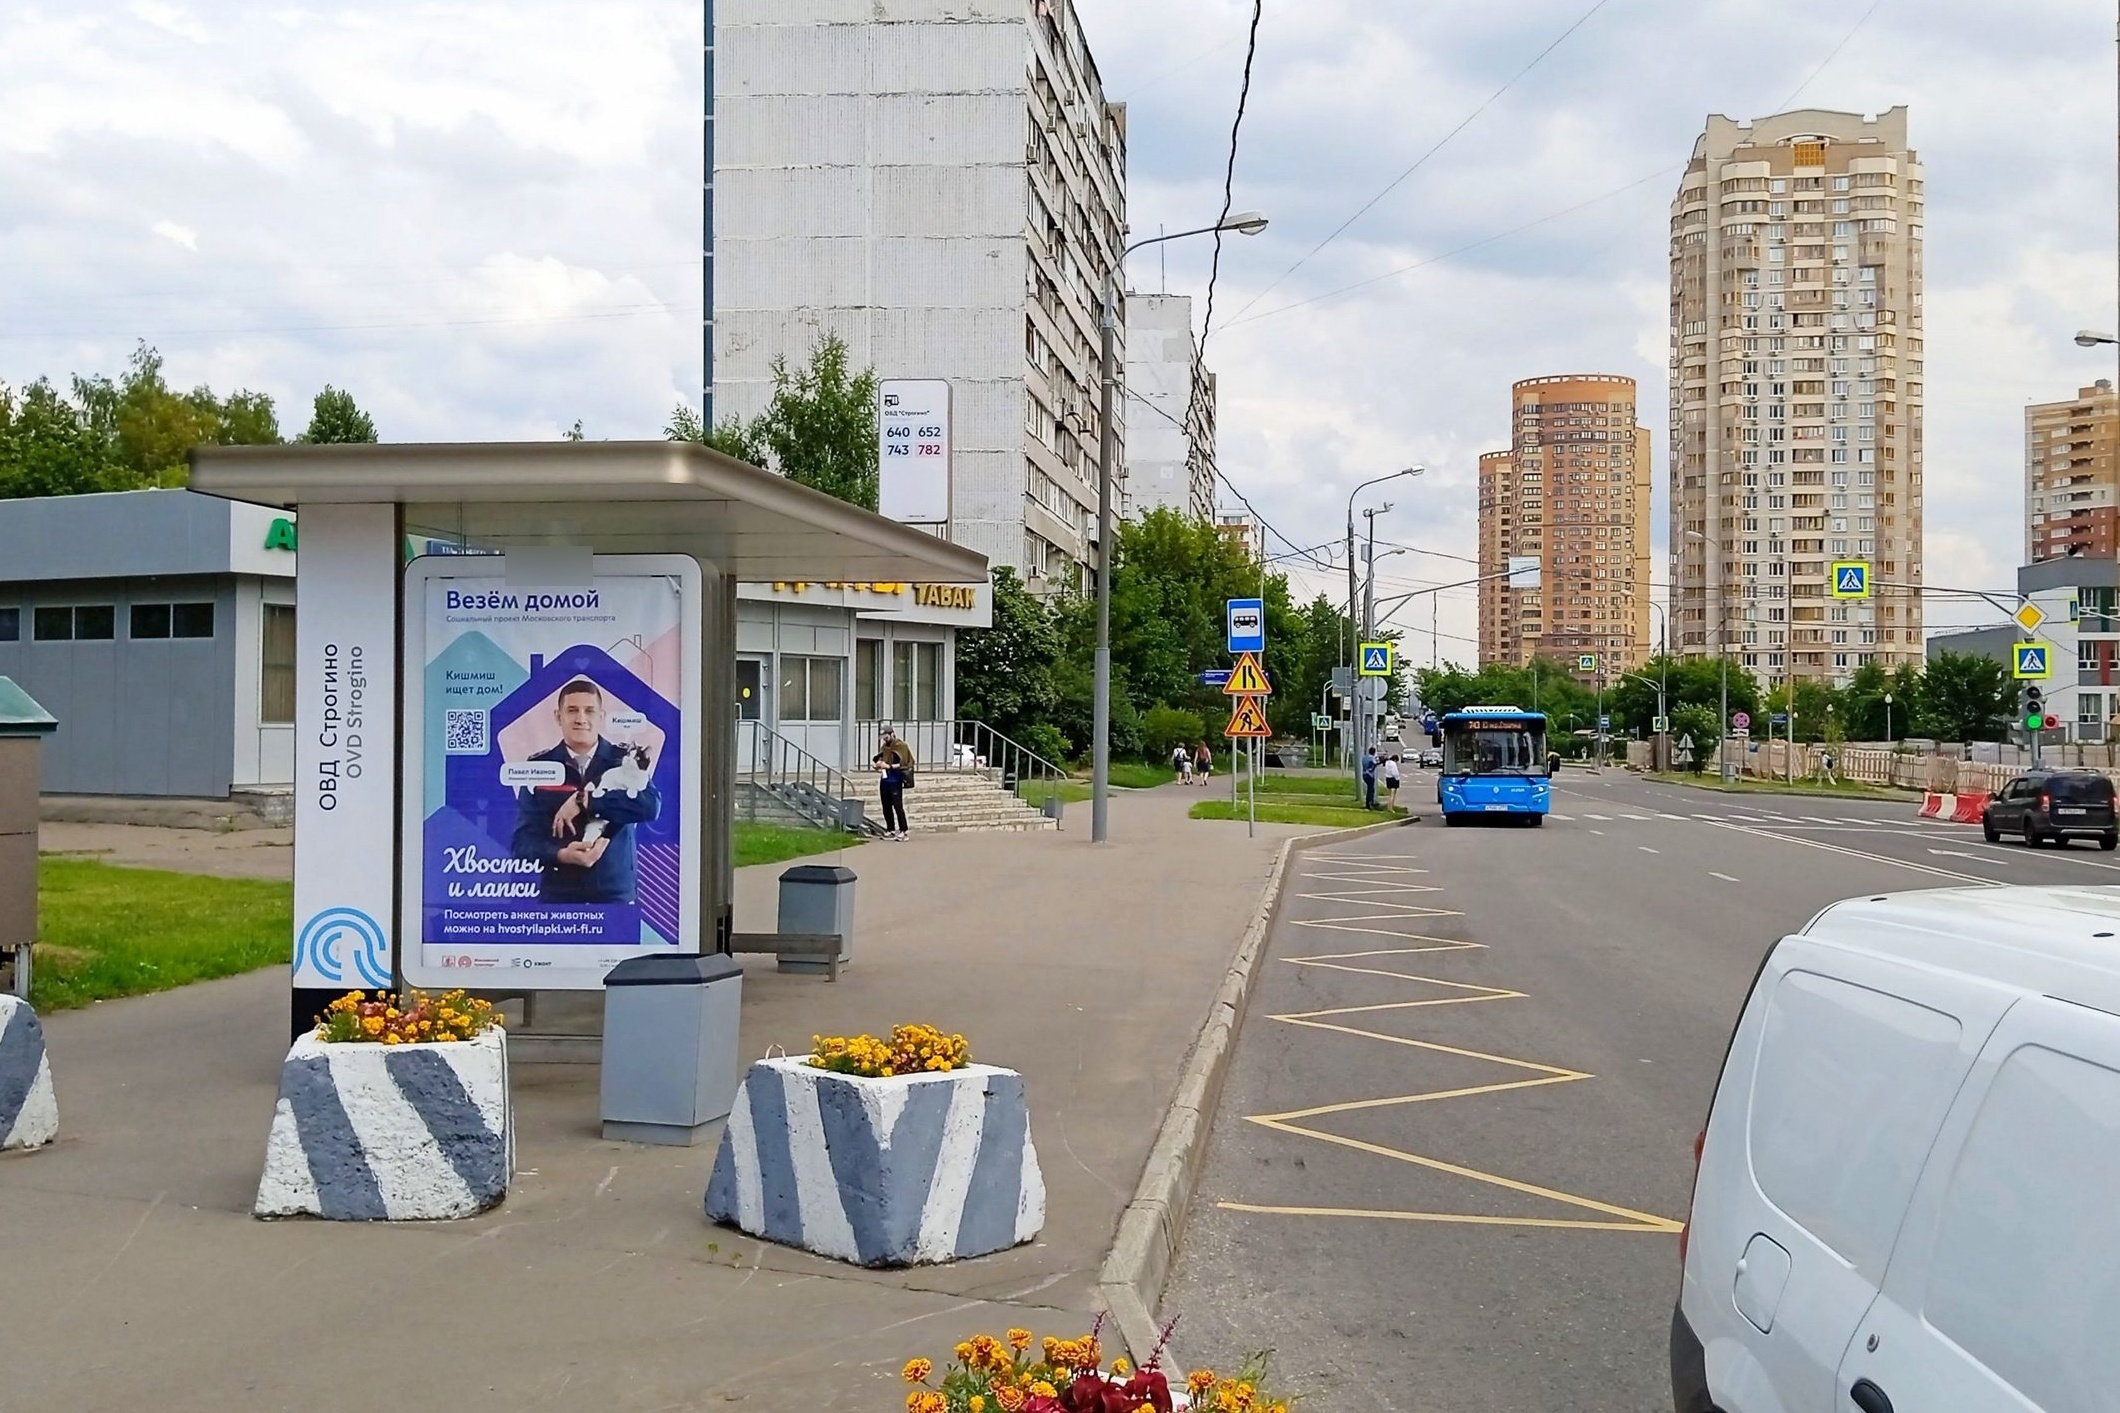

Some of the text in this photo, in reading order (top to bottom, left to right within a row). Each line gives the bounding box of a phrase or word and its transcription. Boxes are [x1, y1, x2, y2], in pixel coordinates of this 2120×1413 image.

[887, 427, 941, 437] 640 652
[887, 445, 941, 455] 743 782
[446, 590, 600, 612] Везём домой
[912, 584, 976, 609] ТАБАК
[446, 670, 496, 681] Кишмиш
[446, 685, 503, 695] ищет дом!
[346, 645, 367, 778] OVD Strogino
[319, 643, 342, 810] ОВД Строгино
[443, 845, 545, 874] Хвосты
[448, 881, 541, 898] и лапки
[444, 909, 605, 922] Посмотреть анкеты животных
[444, 923, 603, 936] можно на hvostyilapki.wi-fi.ru
